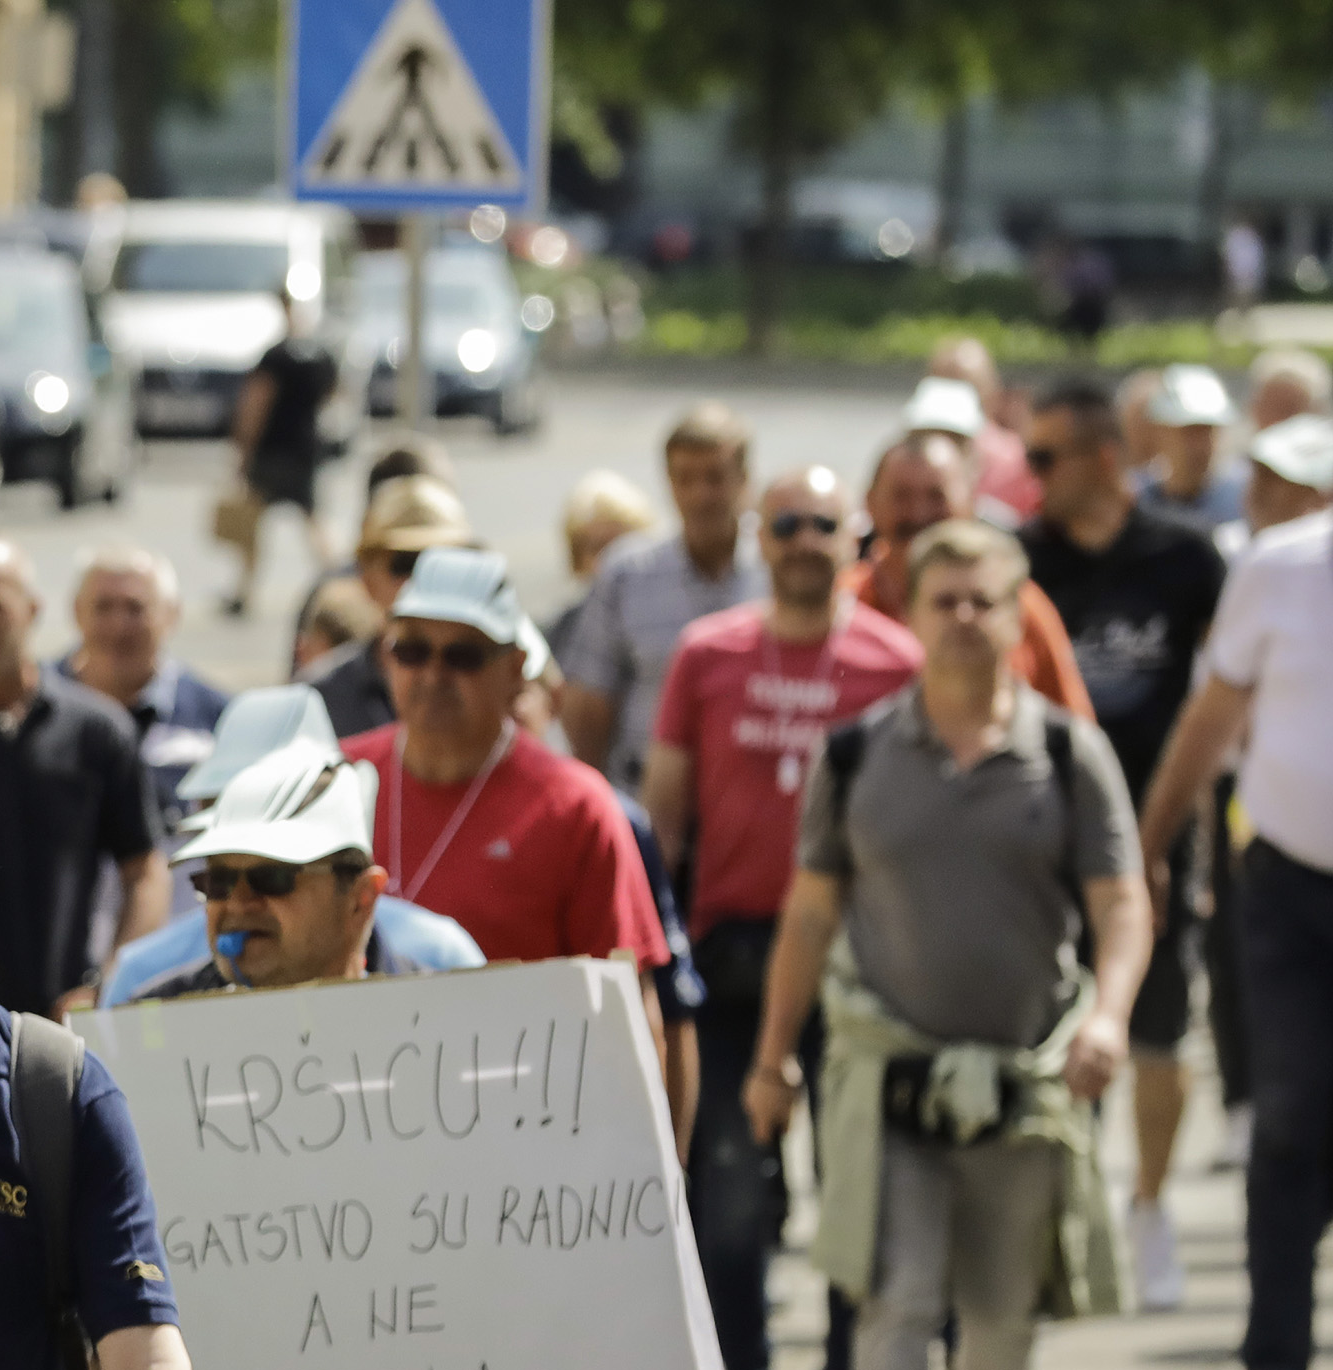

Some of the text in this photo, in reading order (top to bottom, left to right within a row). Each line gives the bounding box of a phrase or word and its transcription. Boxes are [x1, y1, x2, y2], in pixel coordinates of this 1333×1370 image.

[163, 1199, 373, 1272] GATSTVO
[409, 1192, 471, 1255] SU
[299, 1283, 446, 1355] A NE
